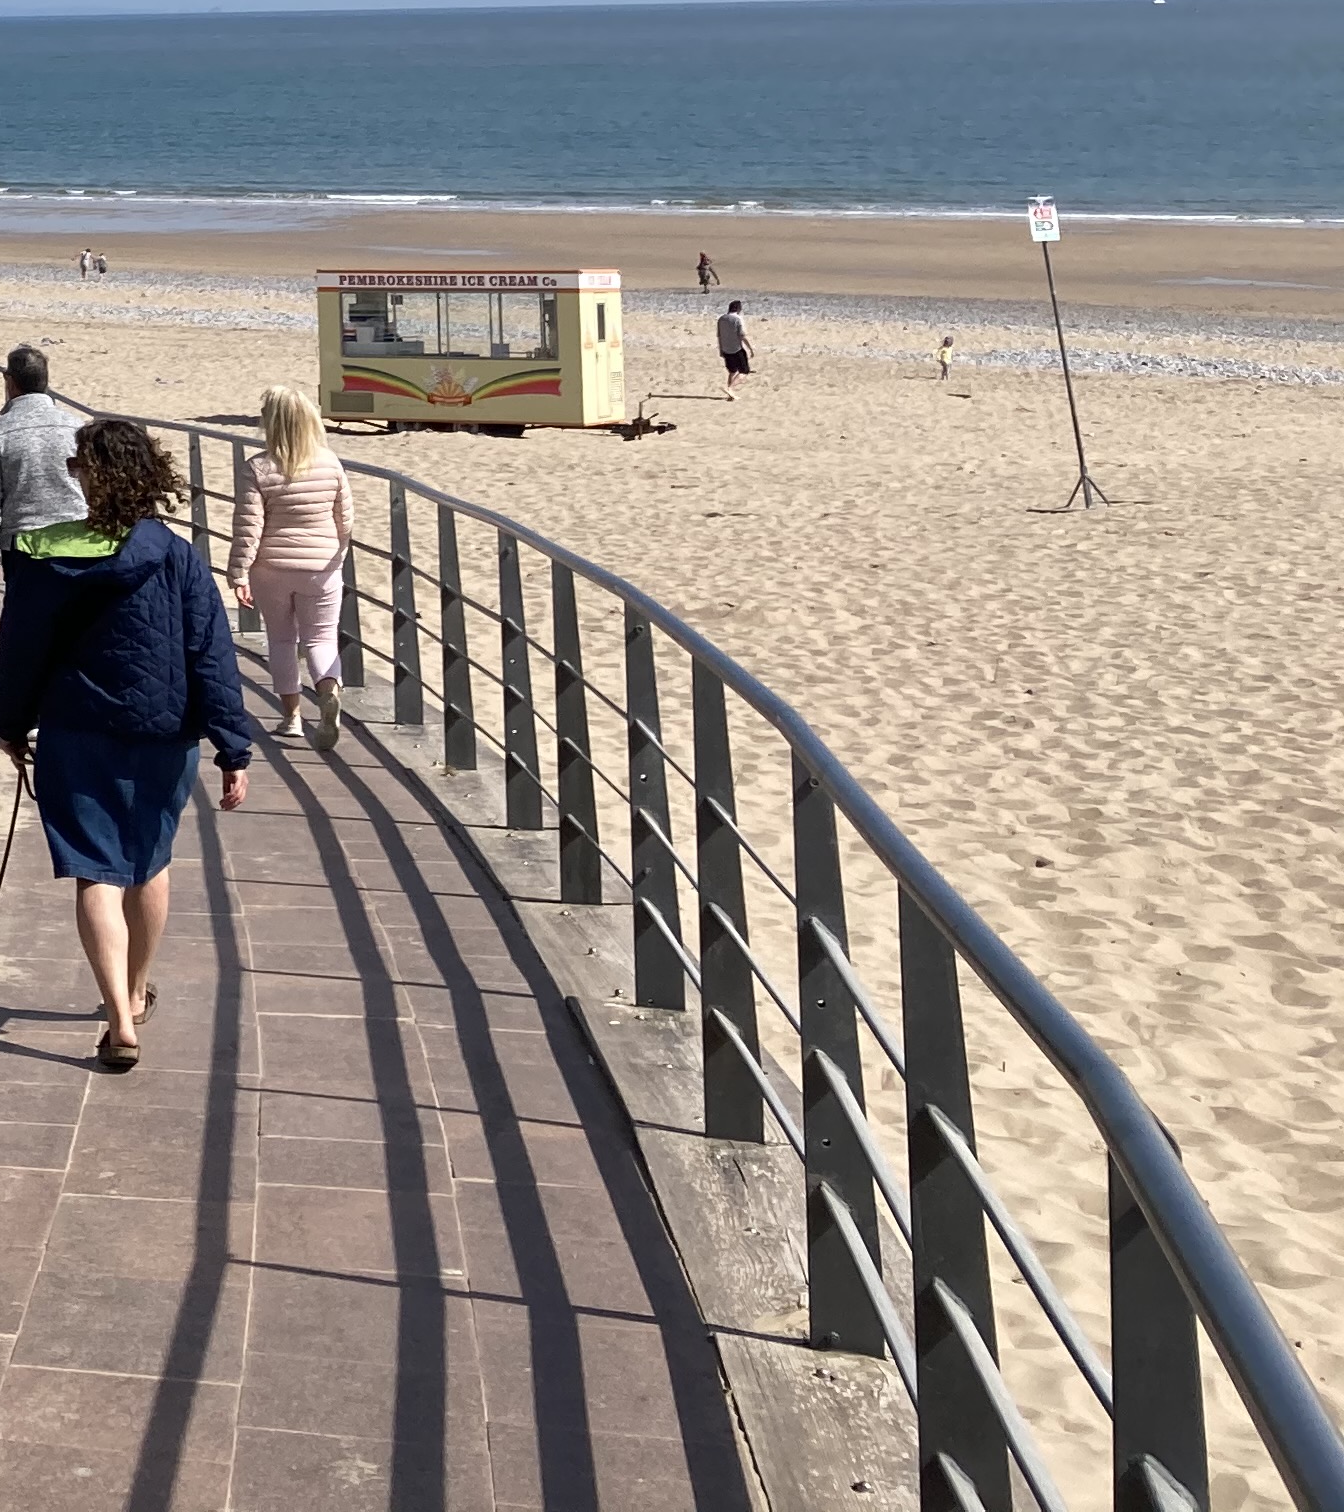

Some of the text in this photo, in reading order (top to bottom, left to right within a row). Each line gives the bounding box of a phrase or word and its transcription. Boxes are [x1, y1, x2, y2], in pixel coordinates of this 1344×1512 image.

[339, 275, 457, 286] PEMBROKESHIRE
[461, 275, 484, 286] ICE
[489, 275, 538, 286] CREAM
